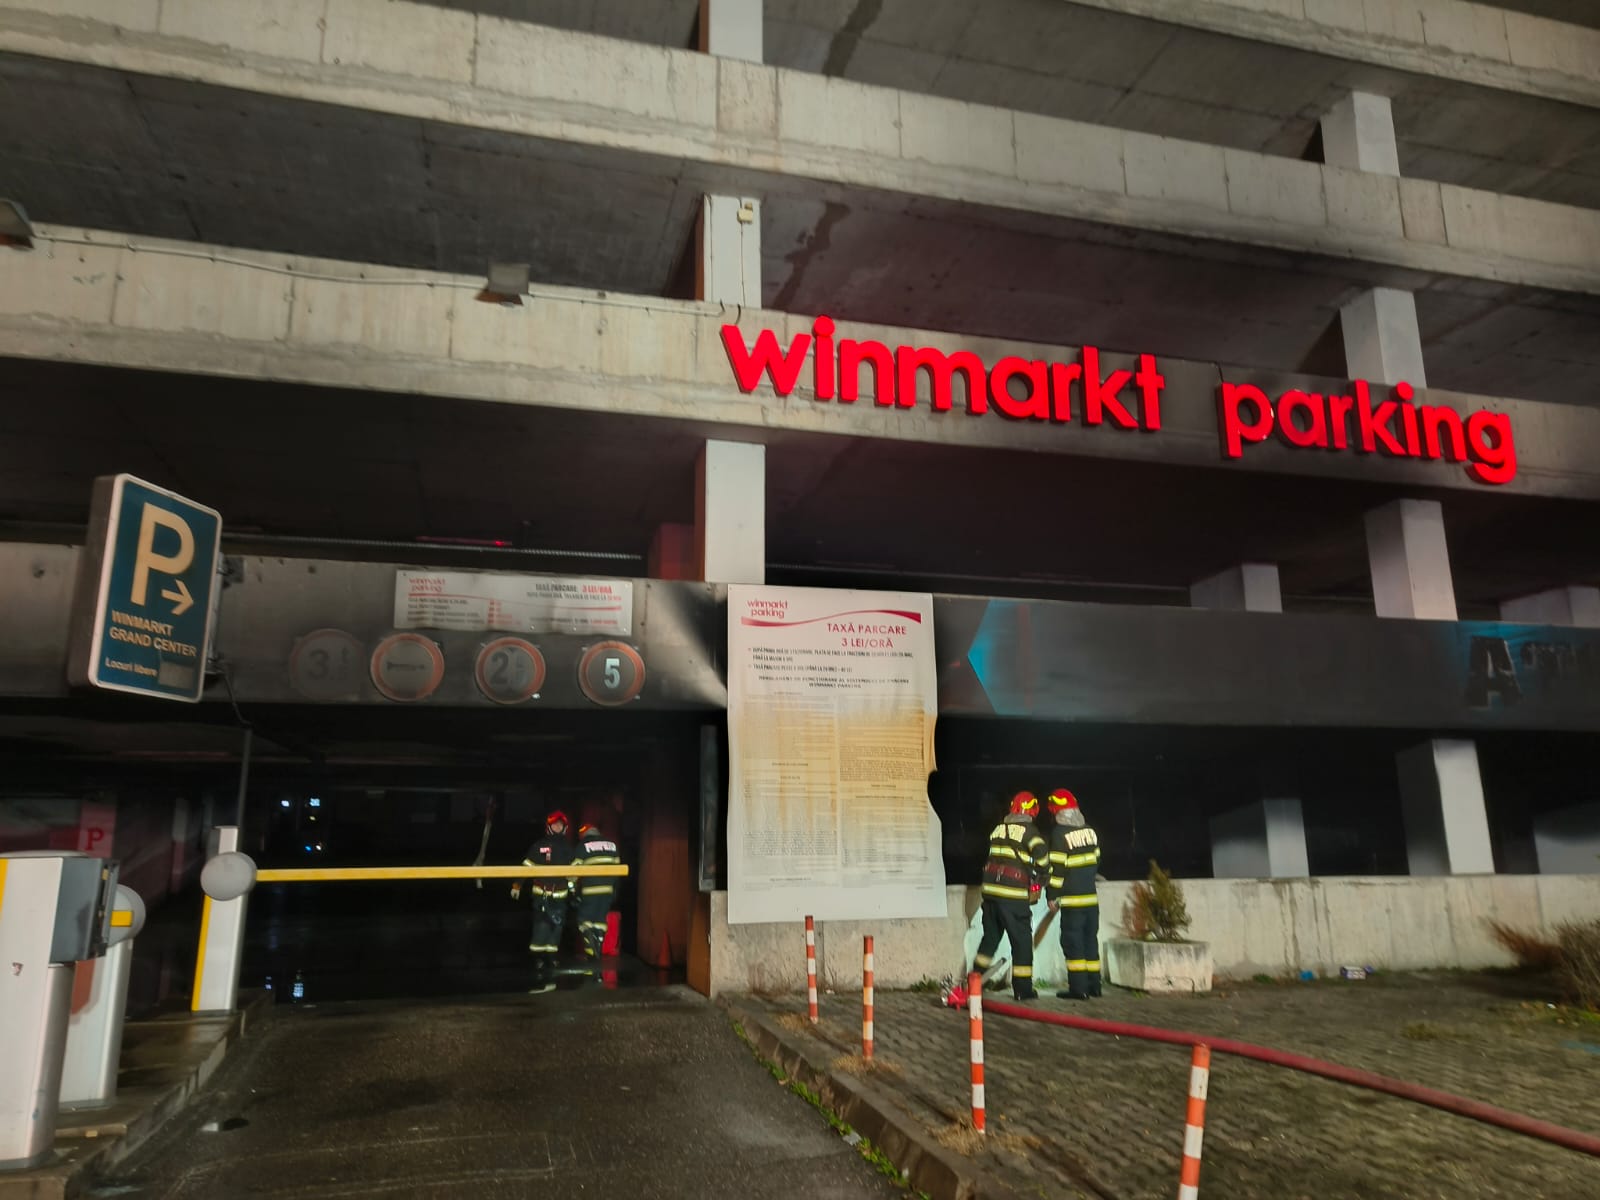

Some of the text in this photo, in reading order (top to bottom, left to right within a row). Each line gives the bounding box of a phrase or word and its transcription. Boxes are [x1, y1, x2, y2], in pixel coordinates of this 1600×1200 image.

[720, 315, 1517, 484] winmarkt parking
[130, 502, 195, 606] P
[747, 598, 788, 609] winmarkt
[750, 608, 785, 619] parking
[111, 610, 174, 636] WINMARKT
[827, 622, 907, 635] TAXĂ PARCARE
[109, 626, 197, 656] GRAND CENTER
[841, 638, 848, 647] 3
[603, 657, 621, 689] 5
[84, 827, 105, 851] P
